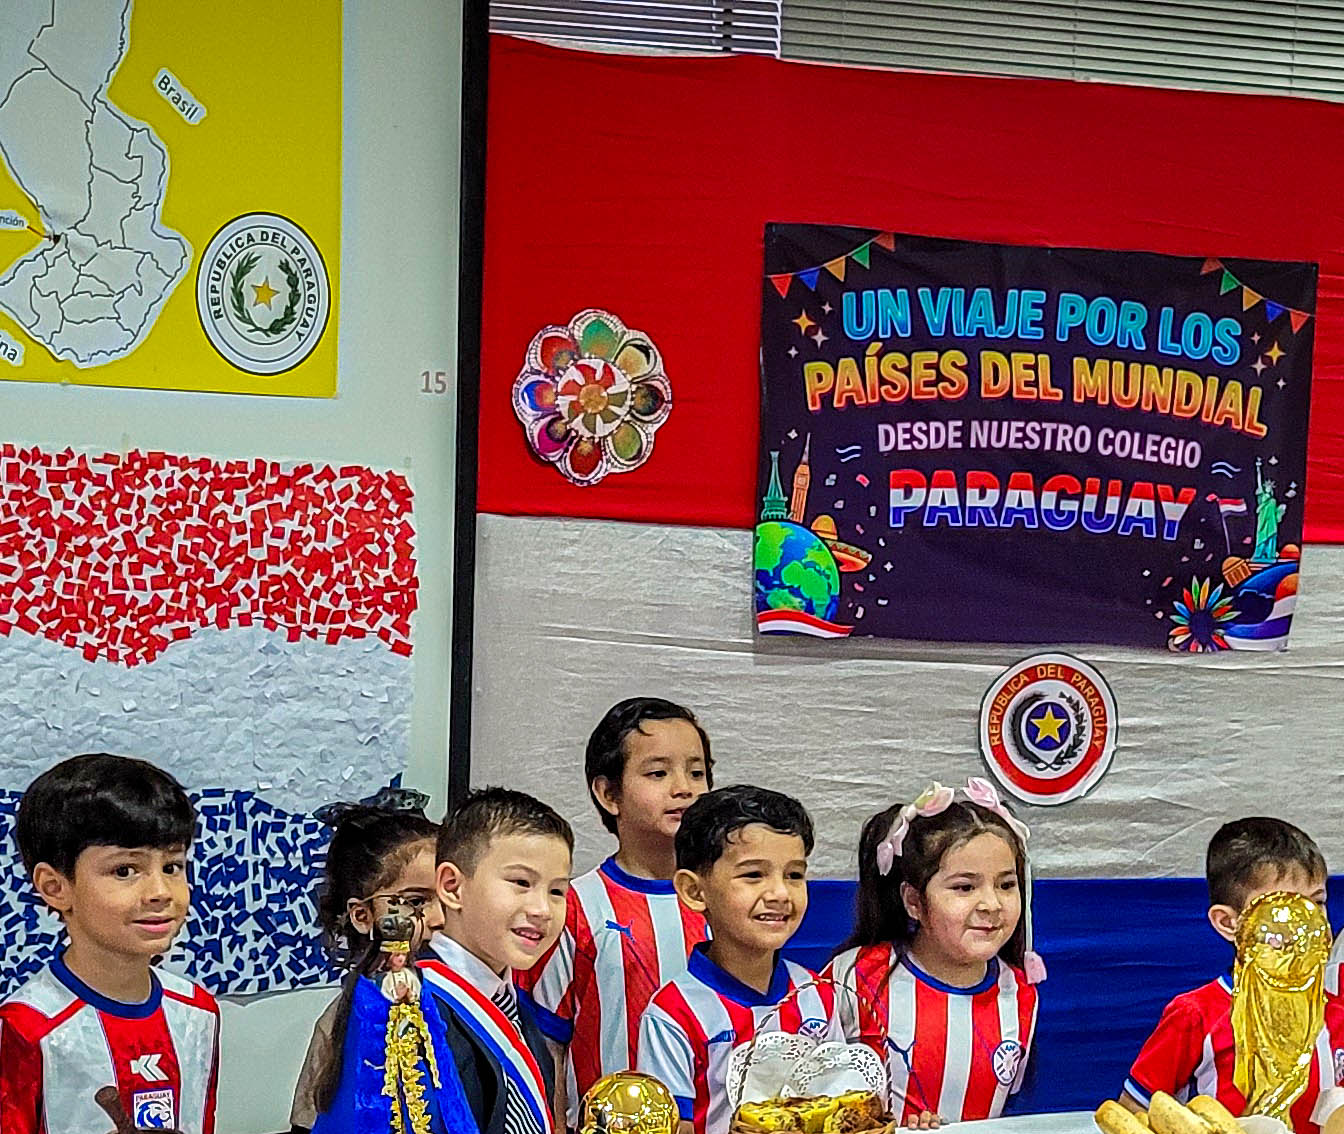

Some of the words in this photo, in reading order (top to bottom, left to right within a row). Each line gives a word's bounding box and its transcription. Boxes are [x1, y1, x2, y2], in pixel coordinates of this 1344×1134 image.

[158, 74, 199, 120] Brasil
[210, 232, 255, 320] REPUBLICA
[260, 230, 288, 248] DEL
[290, 246, 317, 342] PARAGUAY
[841, 288, 912, 339] UN
[917, 286, 1047, 340] VIAJE
[1056, 292, 1147, 351] POR
[1158, 307, 1242, 366] LOS
[421, 371, 447, 394] 15
[803, 341, 969, 411] PAÍSES
[979, 349, 1064, 402] DEL
[1072, 356, 1268, 438] MUNDIAL
[877, 420, 963, 452] DESDE
[970, 420, 1091, 454] NUESTRO
[1097, 430, 1202, 469] COLEGIO
[888, 468, 1197, 541] PARAGUAY
[988, 673, 1030, 747] REPUBLICA
[1036, 664, 1065, 679] DEL
[1071, 672, 1107, 748] PARAGUAY
